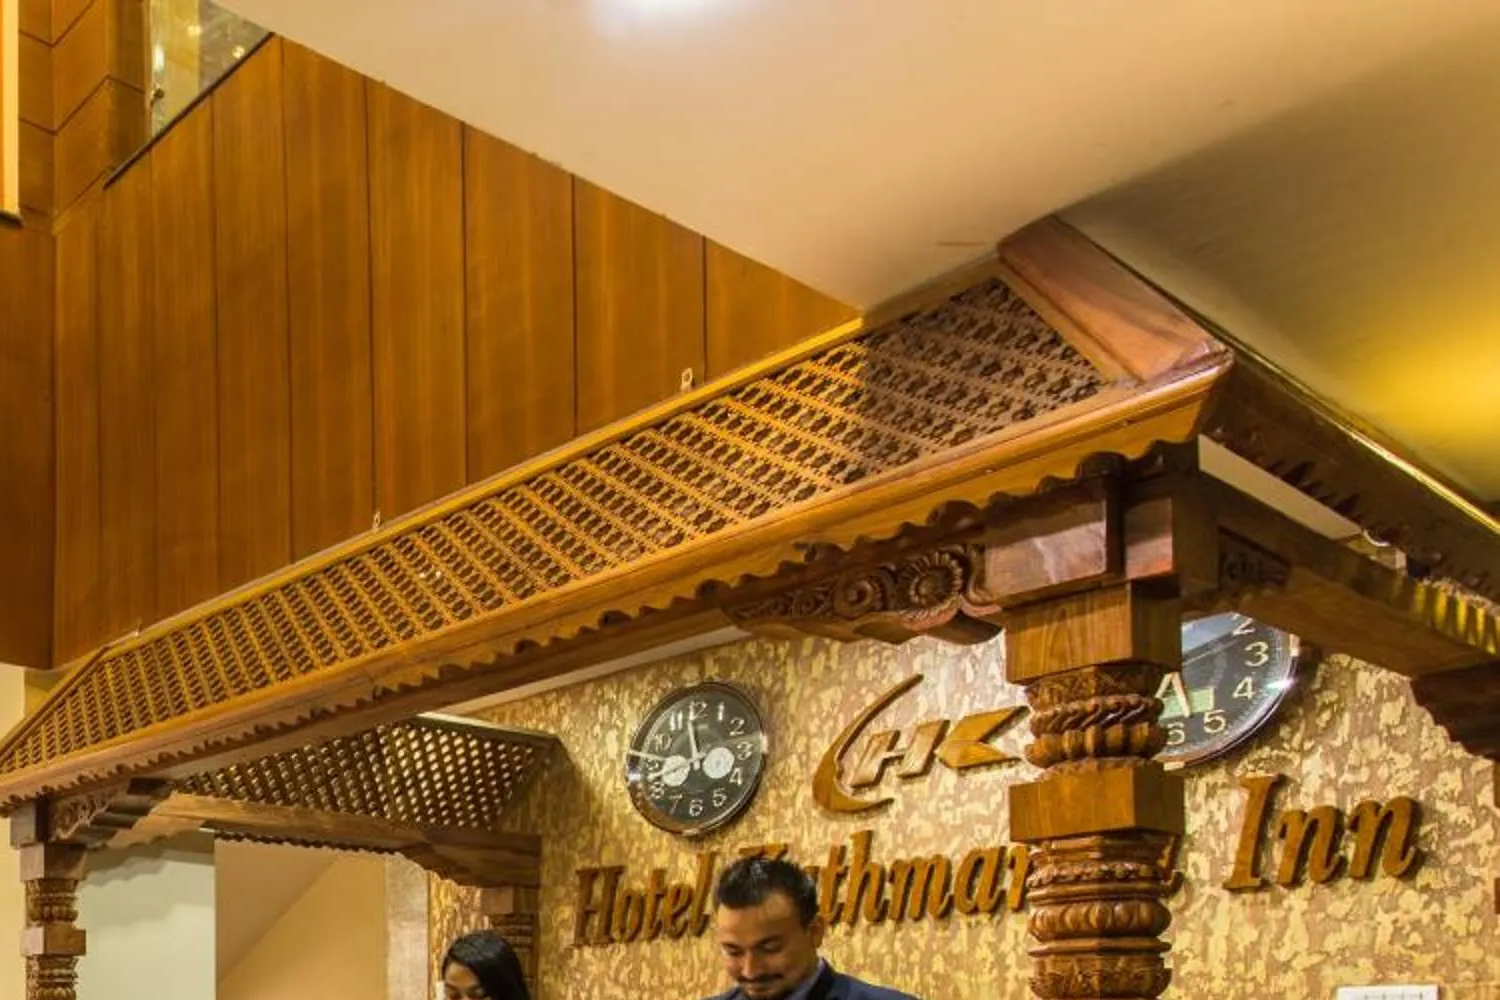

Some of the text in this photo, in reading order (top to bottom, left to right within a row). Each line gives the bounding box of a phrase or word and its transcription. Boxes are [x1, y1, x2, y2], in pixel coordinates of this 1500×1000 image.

[1244, 641, 1269, 667] 3
[1232, 676, 1256, 699] 4
[669, 711, 684, 732] 11
[688, 701, 709, 722] 12
[717, 702, 725, 722] 1
[1203, 708, 1227, 734] 5
[729, 717, 746, 737] 2
[653, 732, 673, 751] 10
[735, 741, 754, 761] 3
[729, 767, 743, 786] 4
[650, 781, 666, 800] 8
[712, 788, 727, 808] 5
[669, 793, 684, 815] 7
[689, 799, 704, 817] 6
[570, 851, 722, 948] Hotel
[1222, 772, 1420, 891] Inn
